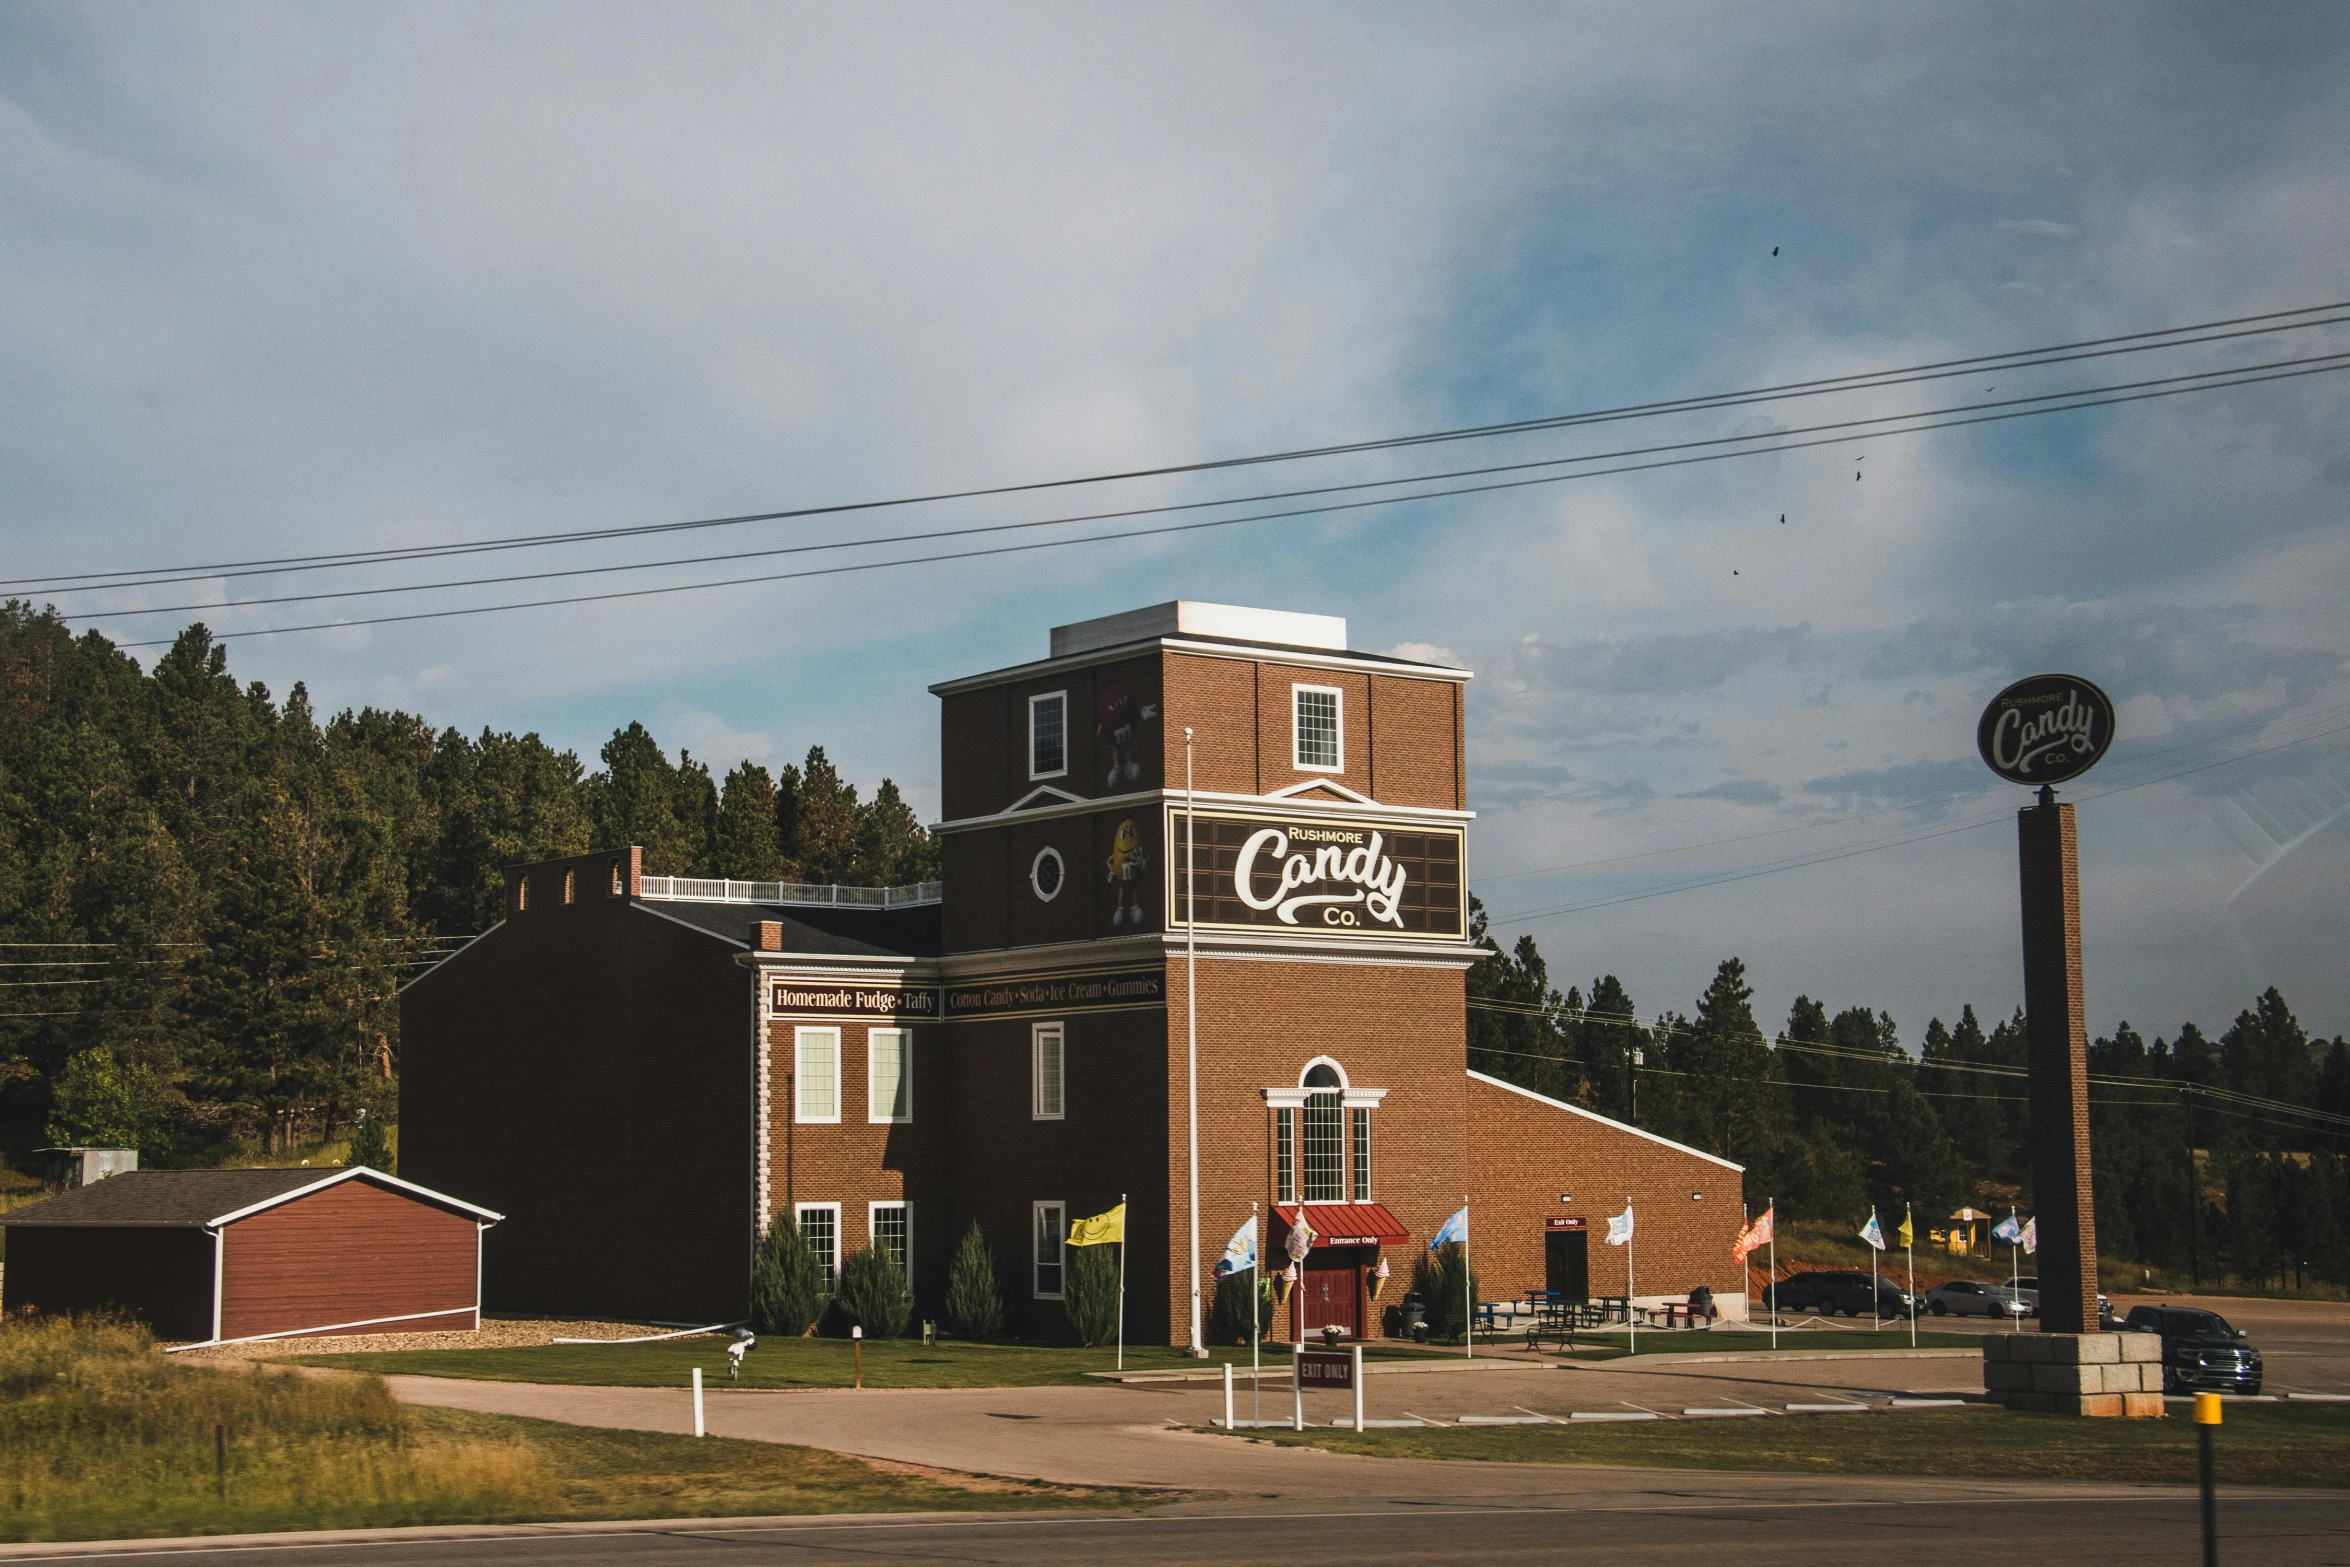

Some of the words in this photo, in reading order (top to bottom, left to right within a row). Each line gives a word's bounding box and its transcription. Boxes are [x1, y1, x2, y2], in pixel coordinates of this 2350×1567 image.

[2001, 693, 2063, 708] RUSHMORE
[1993, 689, 2095, 774] Candy
[1234, 828, 1407, 928] Candy
[777, 989, 852, 1008] Homemade
[855, 990, 896, 1012] Fudge
[903, 992, 934, 1013] Taffy
[950, 992, 982, 1008] Cotton
[984, 987, 1014, 1008] Candy
[1020, 985, 1045, 1004] Soda
[1050, 984, 1065, 1001] Ice
[1068, 982, 1102, 999] Cream
[1107, 976, 1158, 997] Gummies
[1565, 1218, 1578, 1226] Only
[1330, 1237, 1361, 1245] Entrance
[1361, 1236, 1378, 1245] Only
[1302, 1362, 1321, 1378] EXIT
[1324, 1363, 1349, 1379] ONLY
